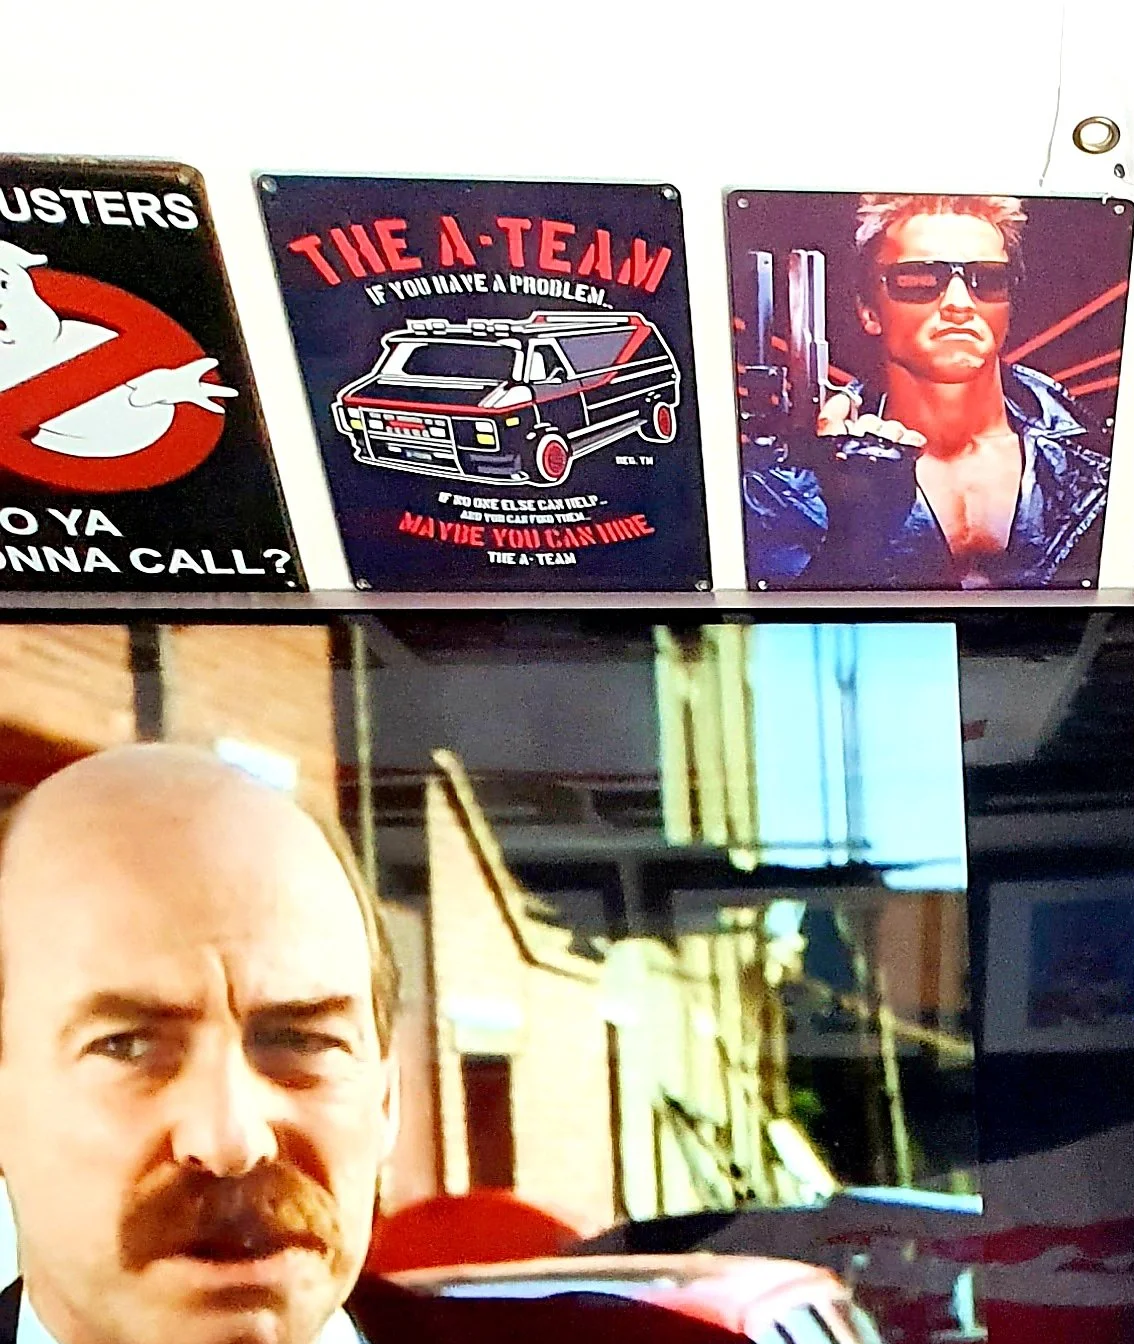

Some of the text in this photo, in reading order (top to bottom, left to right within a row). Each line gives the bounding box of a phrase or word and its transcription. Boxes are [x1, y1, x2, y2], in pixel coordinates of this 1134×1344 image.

[288, 218, 422, 285] THE
[365, 284, 384, 306] IF
[392, 276, 432, 302] YOU
[433, 273, 487, 295] HAVE
[493, 274, 506, 292] A
[473, 496, 499, 511] ONE
[500, 498, 536, 511] ELSE
[536, 498, 565, 511] CAN
[46, 508, 124, 537] YA
[399, 511, 484, 546] MAYBE
[492, 527, 541, 549] YOU
[545, 526, 596, 549] CAN
[130, 546, 291, 574] CALL?
[487, 551, 516, 564] THE
